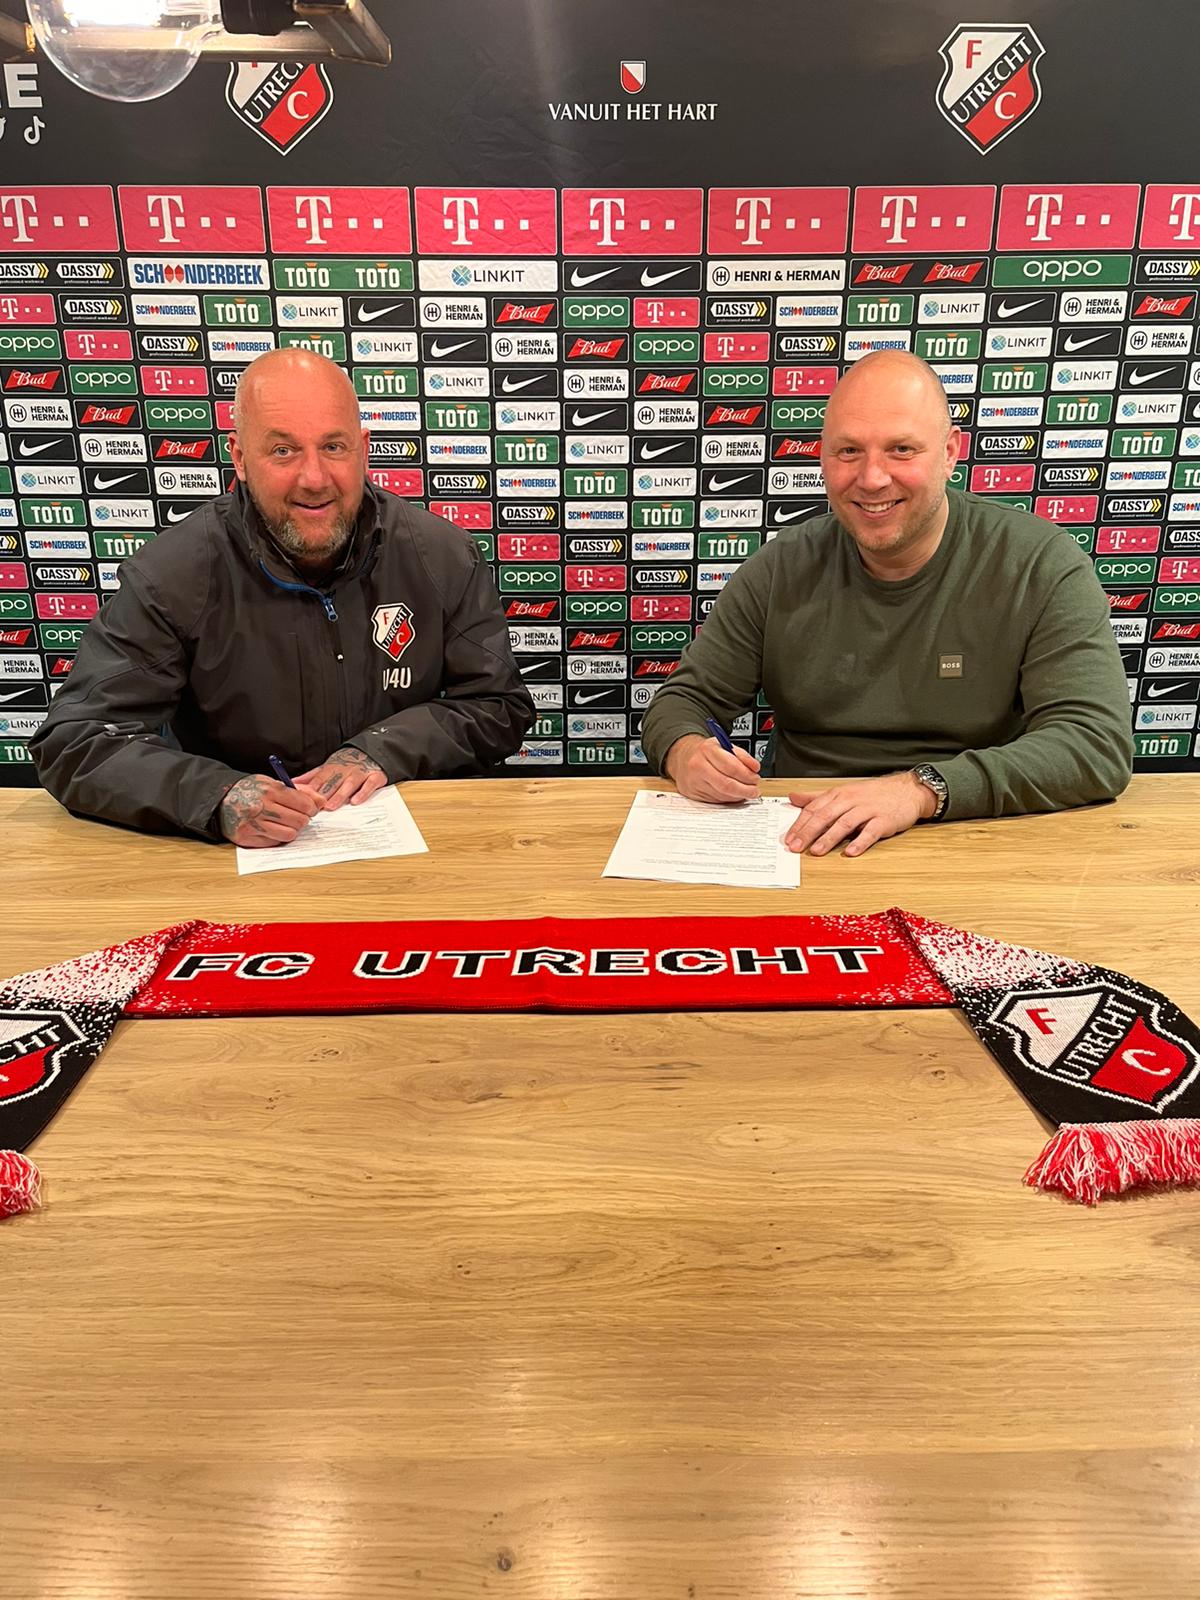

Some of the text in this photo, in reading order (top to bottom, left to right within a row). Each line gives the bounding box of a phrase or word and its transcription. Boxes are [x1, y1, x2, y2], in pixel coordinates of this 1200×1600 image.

[965, 40, 982, 69] F
[951, 37, 1033, 125] UTRECHT
[244, 62, 304, 123] UTREC
[287, 92, 309, 120] C
[549, 103, 717, 121] VANUIT HET HART
[994, 92, 1016, 121] C
[61, 265, 100, 276] DASSY
[866, 263, 898, 279] Bud
[935, 262, 967, 278] Bud
[1023, 260, 1102, 281] oppo
[1149, 262, 1188, 273] DASSY
[285, 267, 330, 287] TOTO
[355, 268, 400, 288] TOTO
[474, 270, 525, 283] LINKIT
[734, 270, 840, 282] HENRI & HERMAN
[69, 301, 108, 313] DASSY
[299, 307, 339, 317] LINKIT
[510, 303, 541, 319] Bud
[568, 304, 625, 319] oppo
[716, 303, 755, 315] DASSY
[941, 304, 980, 313] LINKIT
[1146, 298, 1180, 312] Bud
[214, 303, 260, 323] TOTO
[857, 303, 900, 322] TOTO
[147, 337, 185, 350] DASSY
[374, 342, 413, 352] LINKIT
[580, 339, 610, 354] Bud
[639, 339, 695, 355] oppo
[785, 339, 823, 350] DASSY
[926, 338, 968, 356] TOTO
[1008, 338, 1047, 347] LINKIT
[14, 372, 47, 385] Bud
[75, 372, 131, 387] oppo
[446, 377, 485, 387] LINKIT
[650, 373, 680, 388] Bud
[709, 374, 763, 389] oppo
[992, 370, 1034, 389] TOTO
[1073, 371, 1112, 381] LINKIT
[363, 375, 406, 394] TOTO
[90, 407, 123, 420] Bud
[151, 406, 206, 422] oppo
[517, 410, 556, 421] LINKIT
[717, 405, 749, 421] Bud
[1057, 403, 1099, 421] TOTO
[1138, 404, 1176, 413] LINKIT
[435, 409, 479, 427] TOTO
[659, 415, 695, 423] HERMAN
[167, 441, 197, 455] Bud
[586, 444, 624, 455] LINKIT
[786, 439, 817, 453] Bud
[985, 438, 1023, 449] DASSY
[1122, 437, 1163, 454] TOTO
[505, 442, 548, 461] TOTO
[37, 476, 75, 485] LINKIT
[1049, 469, 1088, 480] DASSY
[437, 476, 475, 488] DASSY
[574, 475, 616, 494] TOTO
[654, 477, 692, 487] LINKIT
[1112, 501, 1150, 511] DASSY
[31, 506, 74, 523] TOTO
[111, 509, 149, 518] LINKIT
[507, 508, 543, 519] DASSY
[641, 508, 682, 525] TOTO
[721, 509, 758, 518] LINKIT
[574, 540, 610, 551] DASSY
[708, 540, 749, 556] TOTO
[41, 569, 77, 579] DASSY
[640, 572, 676, 582] DASSY
[1099, 563, 1151, 577] oppo
[504, 571, 556, 585] oppo
[516, 602, 544, 613] Bud
[571, 601, 621, 614] oppo
[383, 611, 390, 625] F
[1164, 624, 1194, 635] Bud
[396, 631, 405, 645] C
[582, 632, 610, 644] Bud
[636, 631, 687, 644] oppo
[647, 659, 675, 672] Bud
[586, 722, 621, 730] LINKIT
[1141, 739, 1178, 754] TOTO
[577, 747, 614, 761] TOTO
[166, 946, 883, 981] FC UTRECHT
[1025, 1007, 1056, 1035] F
[1056, 993, 1136, 1081] UTRECHT
[1121, 1049, 1171, 1076] C
